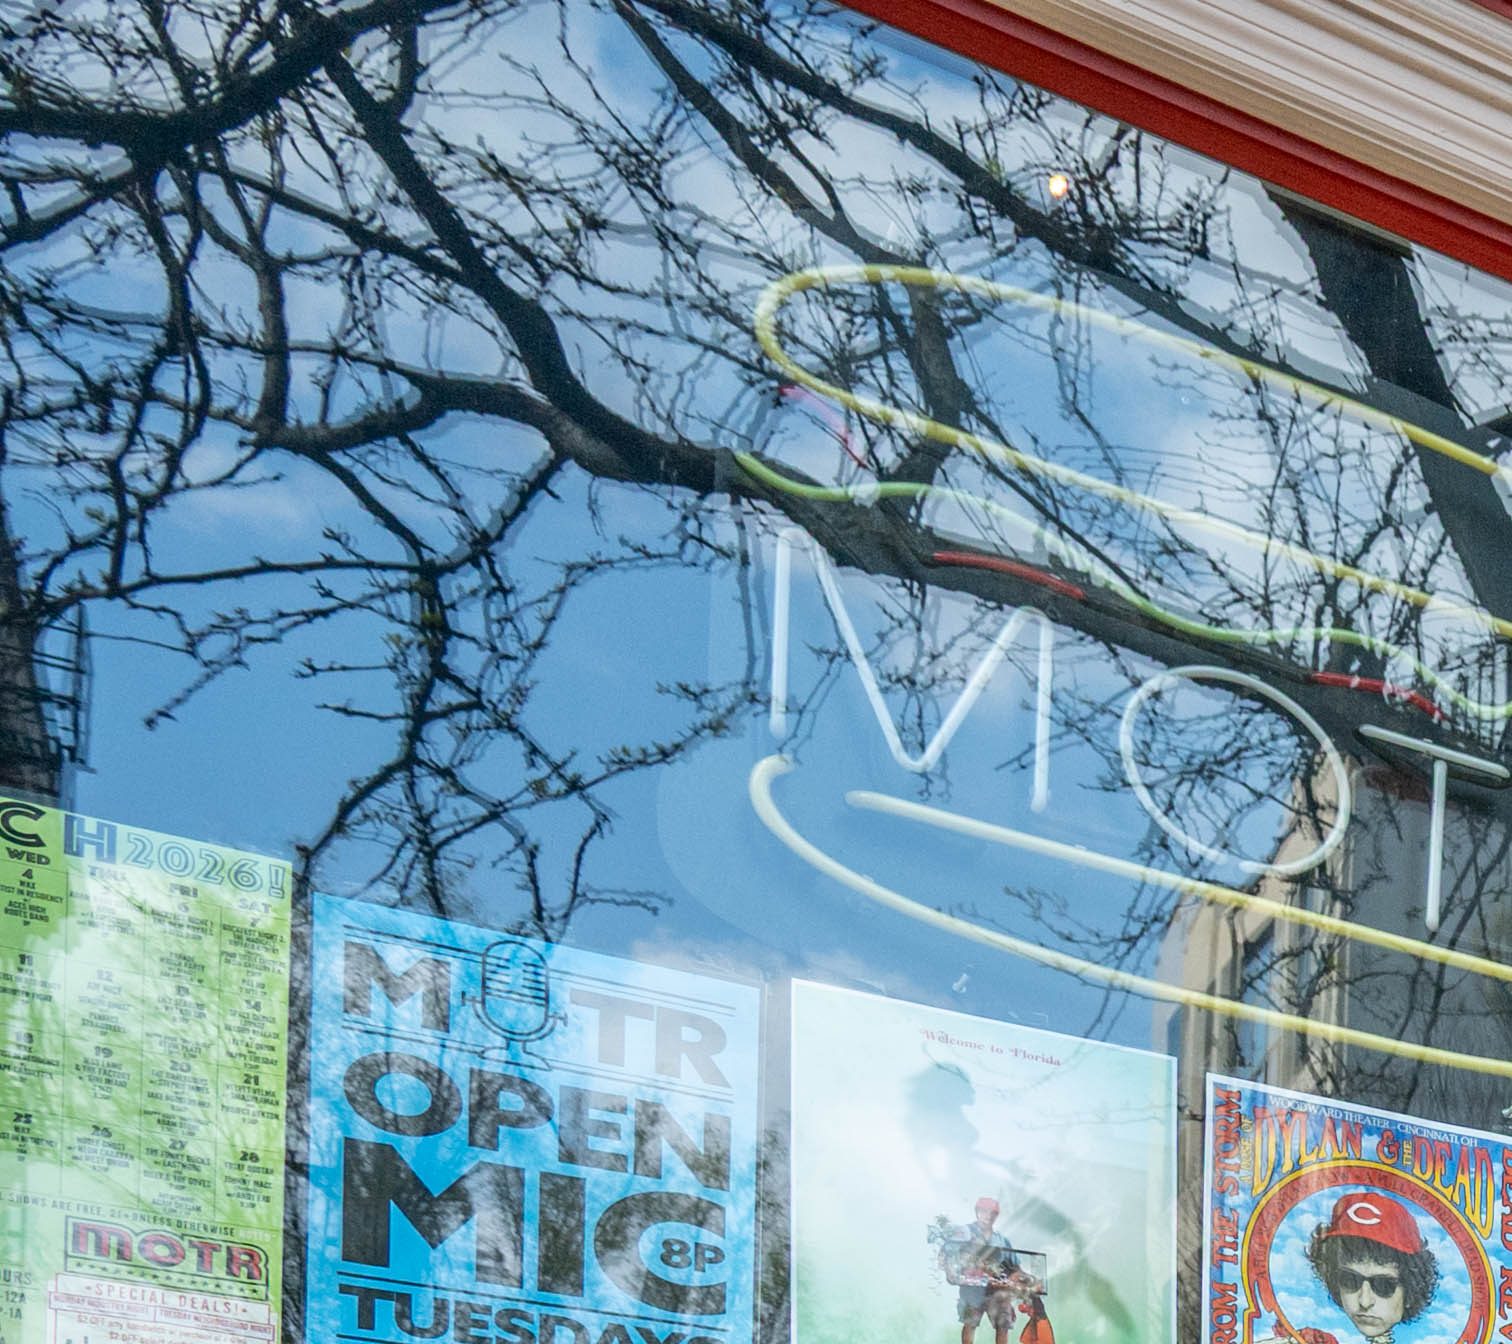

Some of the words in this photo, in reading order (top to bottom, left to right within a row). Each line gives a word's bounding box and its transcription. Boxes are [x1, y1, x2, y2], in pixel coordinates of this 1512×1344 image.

[5, 846, 50, 866] WED
[123, 832, 286, 899] 2026!
[342, 1051, 731, 1192] OPEN
[1214, 1088, 1243, 1196] STORM
[1252, 1106, 1363, 1197] DYLAN
[1412, 1141, 1495, 1240] DEAD
[71, 1222, 262, 1281] MOTR
[341, 1136, 727, 1316] MIC
[661, 1237, 726, 1274] 8P
[1212, 1206, 1239, 1276] THE
